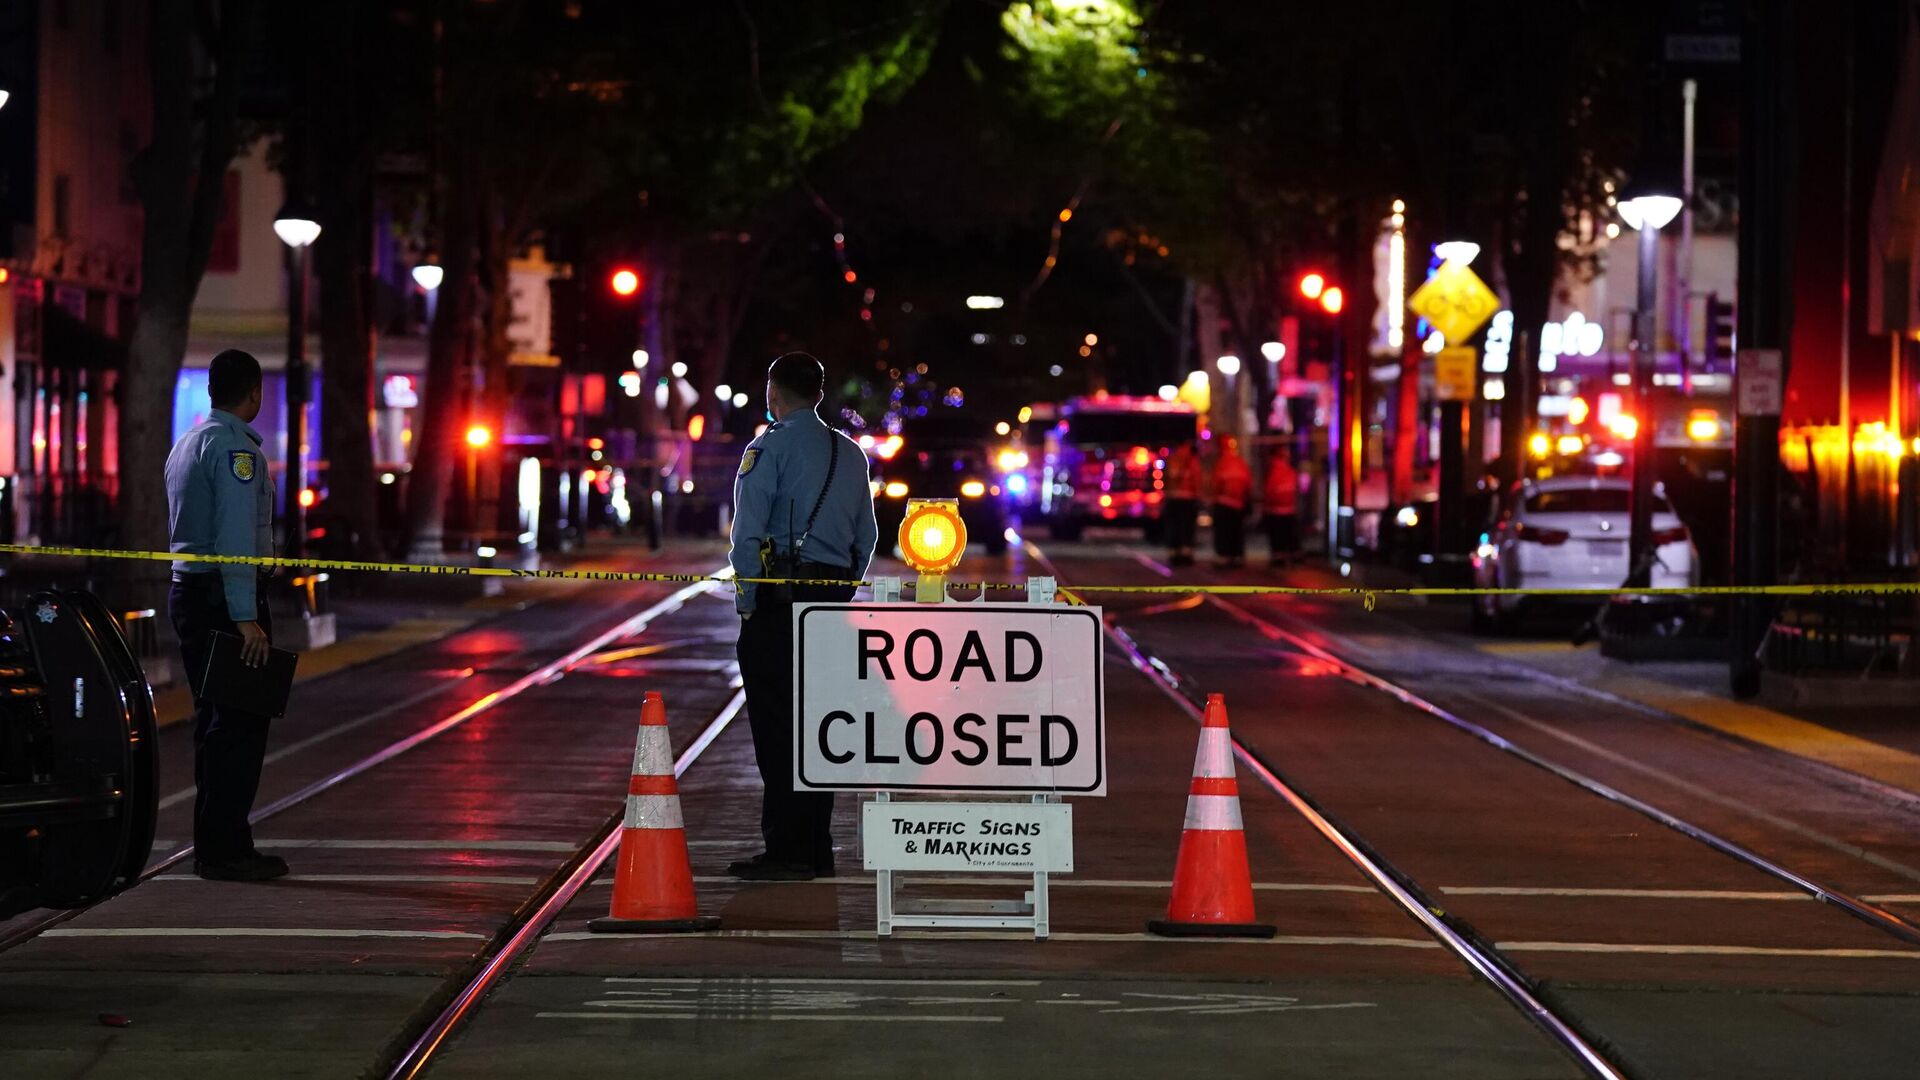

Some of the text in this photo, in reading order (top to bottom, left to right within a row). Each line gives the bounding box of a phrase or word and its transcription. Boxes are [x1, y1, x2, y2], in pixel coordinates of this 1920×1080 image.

[858, 628, 1043, 683] ROAD
[817, 710, 1079, 767] CLOSED
[905, 840, 918, 853] &
